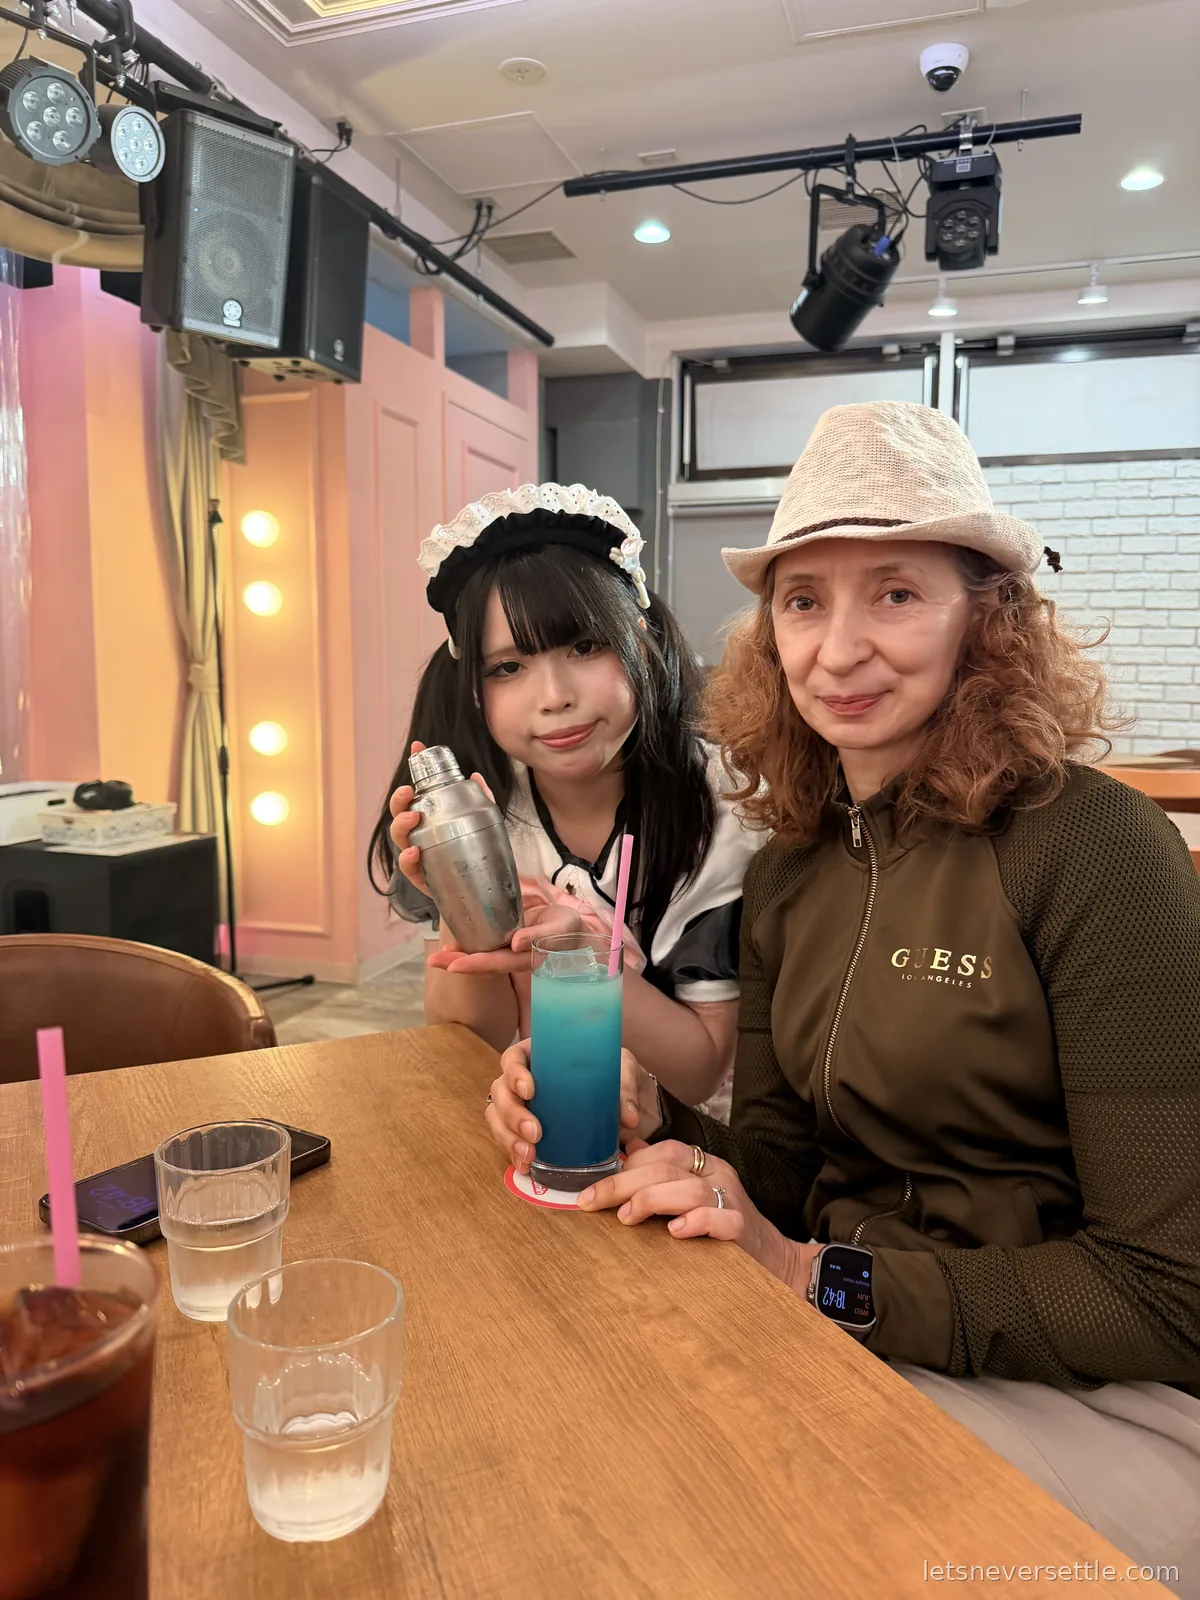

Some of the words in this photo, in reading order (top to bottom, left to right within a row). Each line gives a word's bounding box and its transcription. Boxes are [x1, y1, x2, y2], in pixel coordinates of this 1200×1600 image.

[891, 948, 992, 979] GUESS
[920, 974, 972, 989] ANGELES
[89, 1183, 156, 1213] 18:42
[822, 1286, 846, 1310] 18:42
[857, 1292, 871, 1301] JUN
[854, 1307, 869, 1317] WED
[864, 1302, 870, 1310] 3
